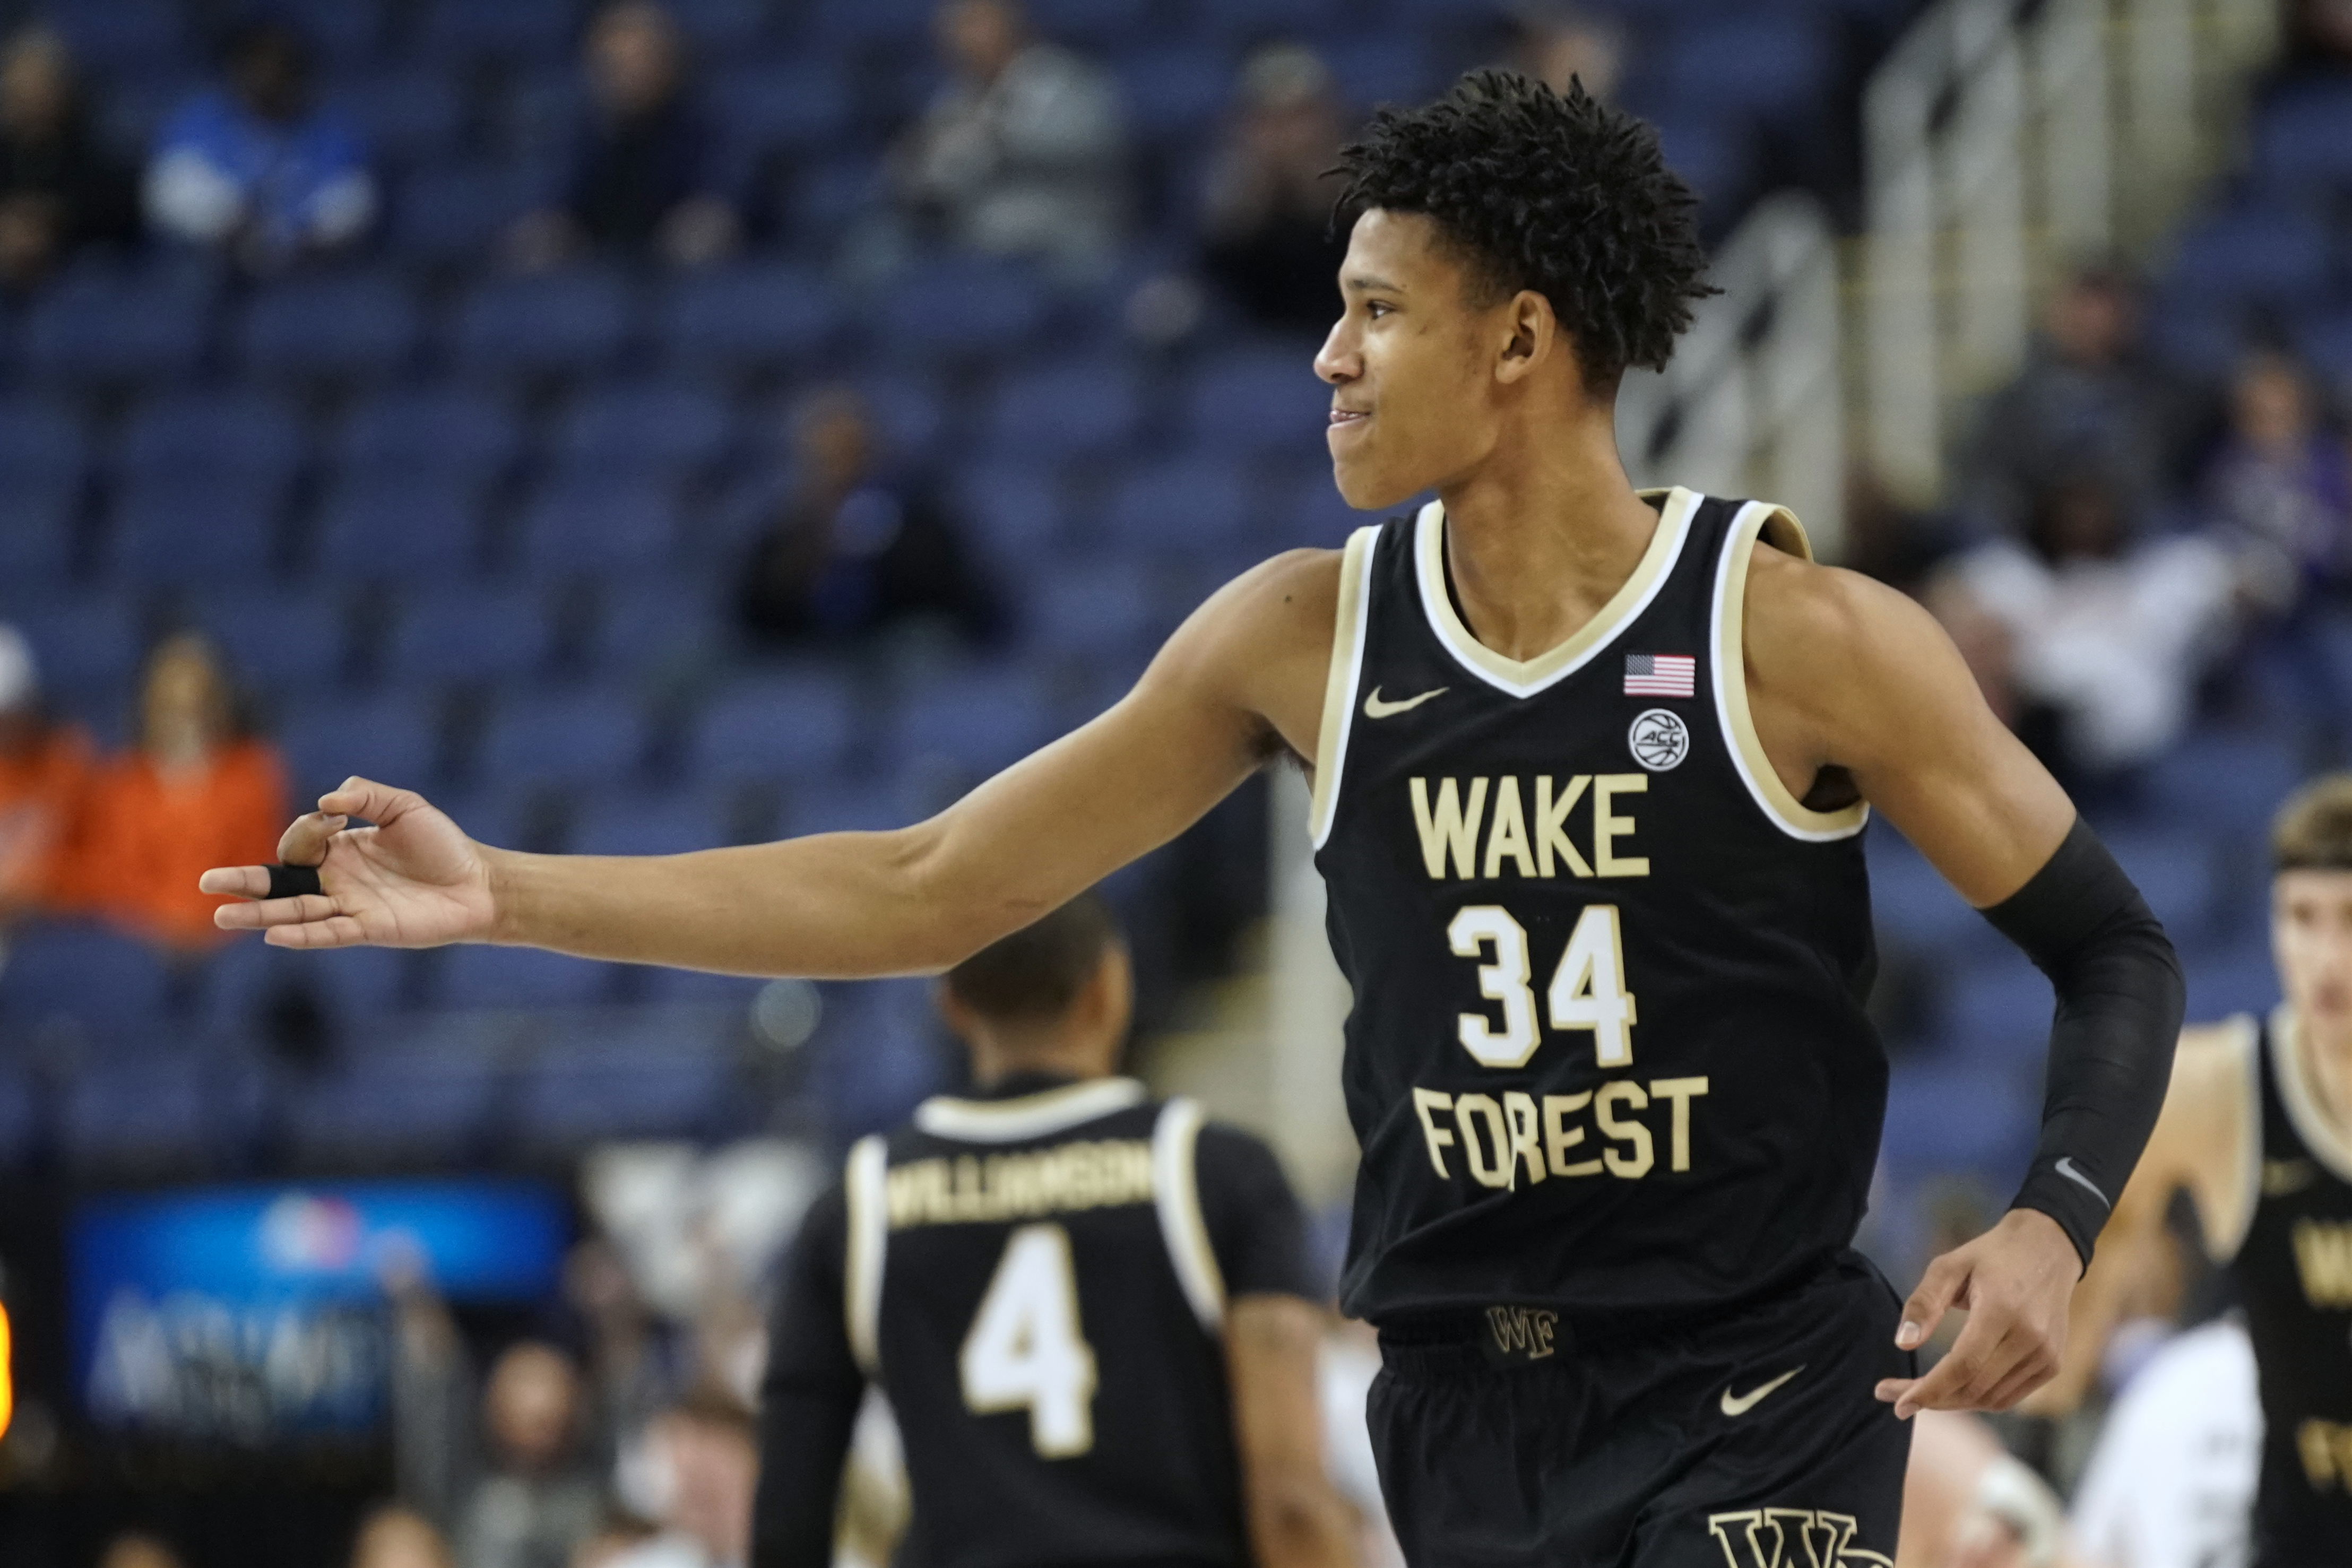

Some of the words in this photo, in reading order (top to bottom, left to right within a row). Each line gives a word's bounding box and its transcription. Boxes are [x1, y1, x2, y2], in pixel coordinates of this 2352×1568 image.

[1410, 773, 1650, 880] WAKE
[1447, 904, 1637, 1068] 34
[1412, 1076, 1709, 1193] FOREST
[961, 1224, 1097, 1459] 4
[1488, 1305, 1558, 1358] WF
